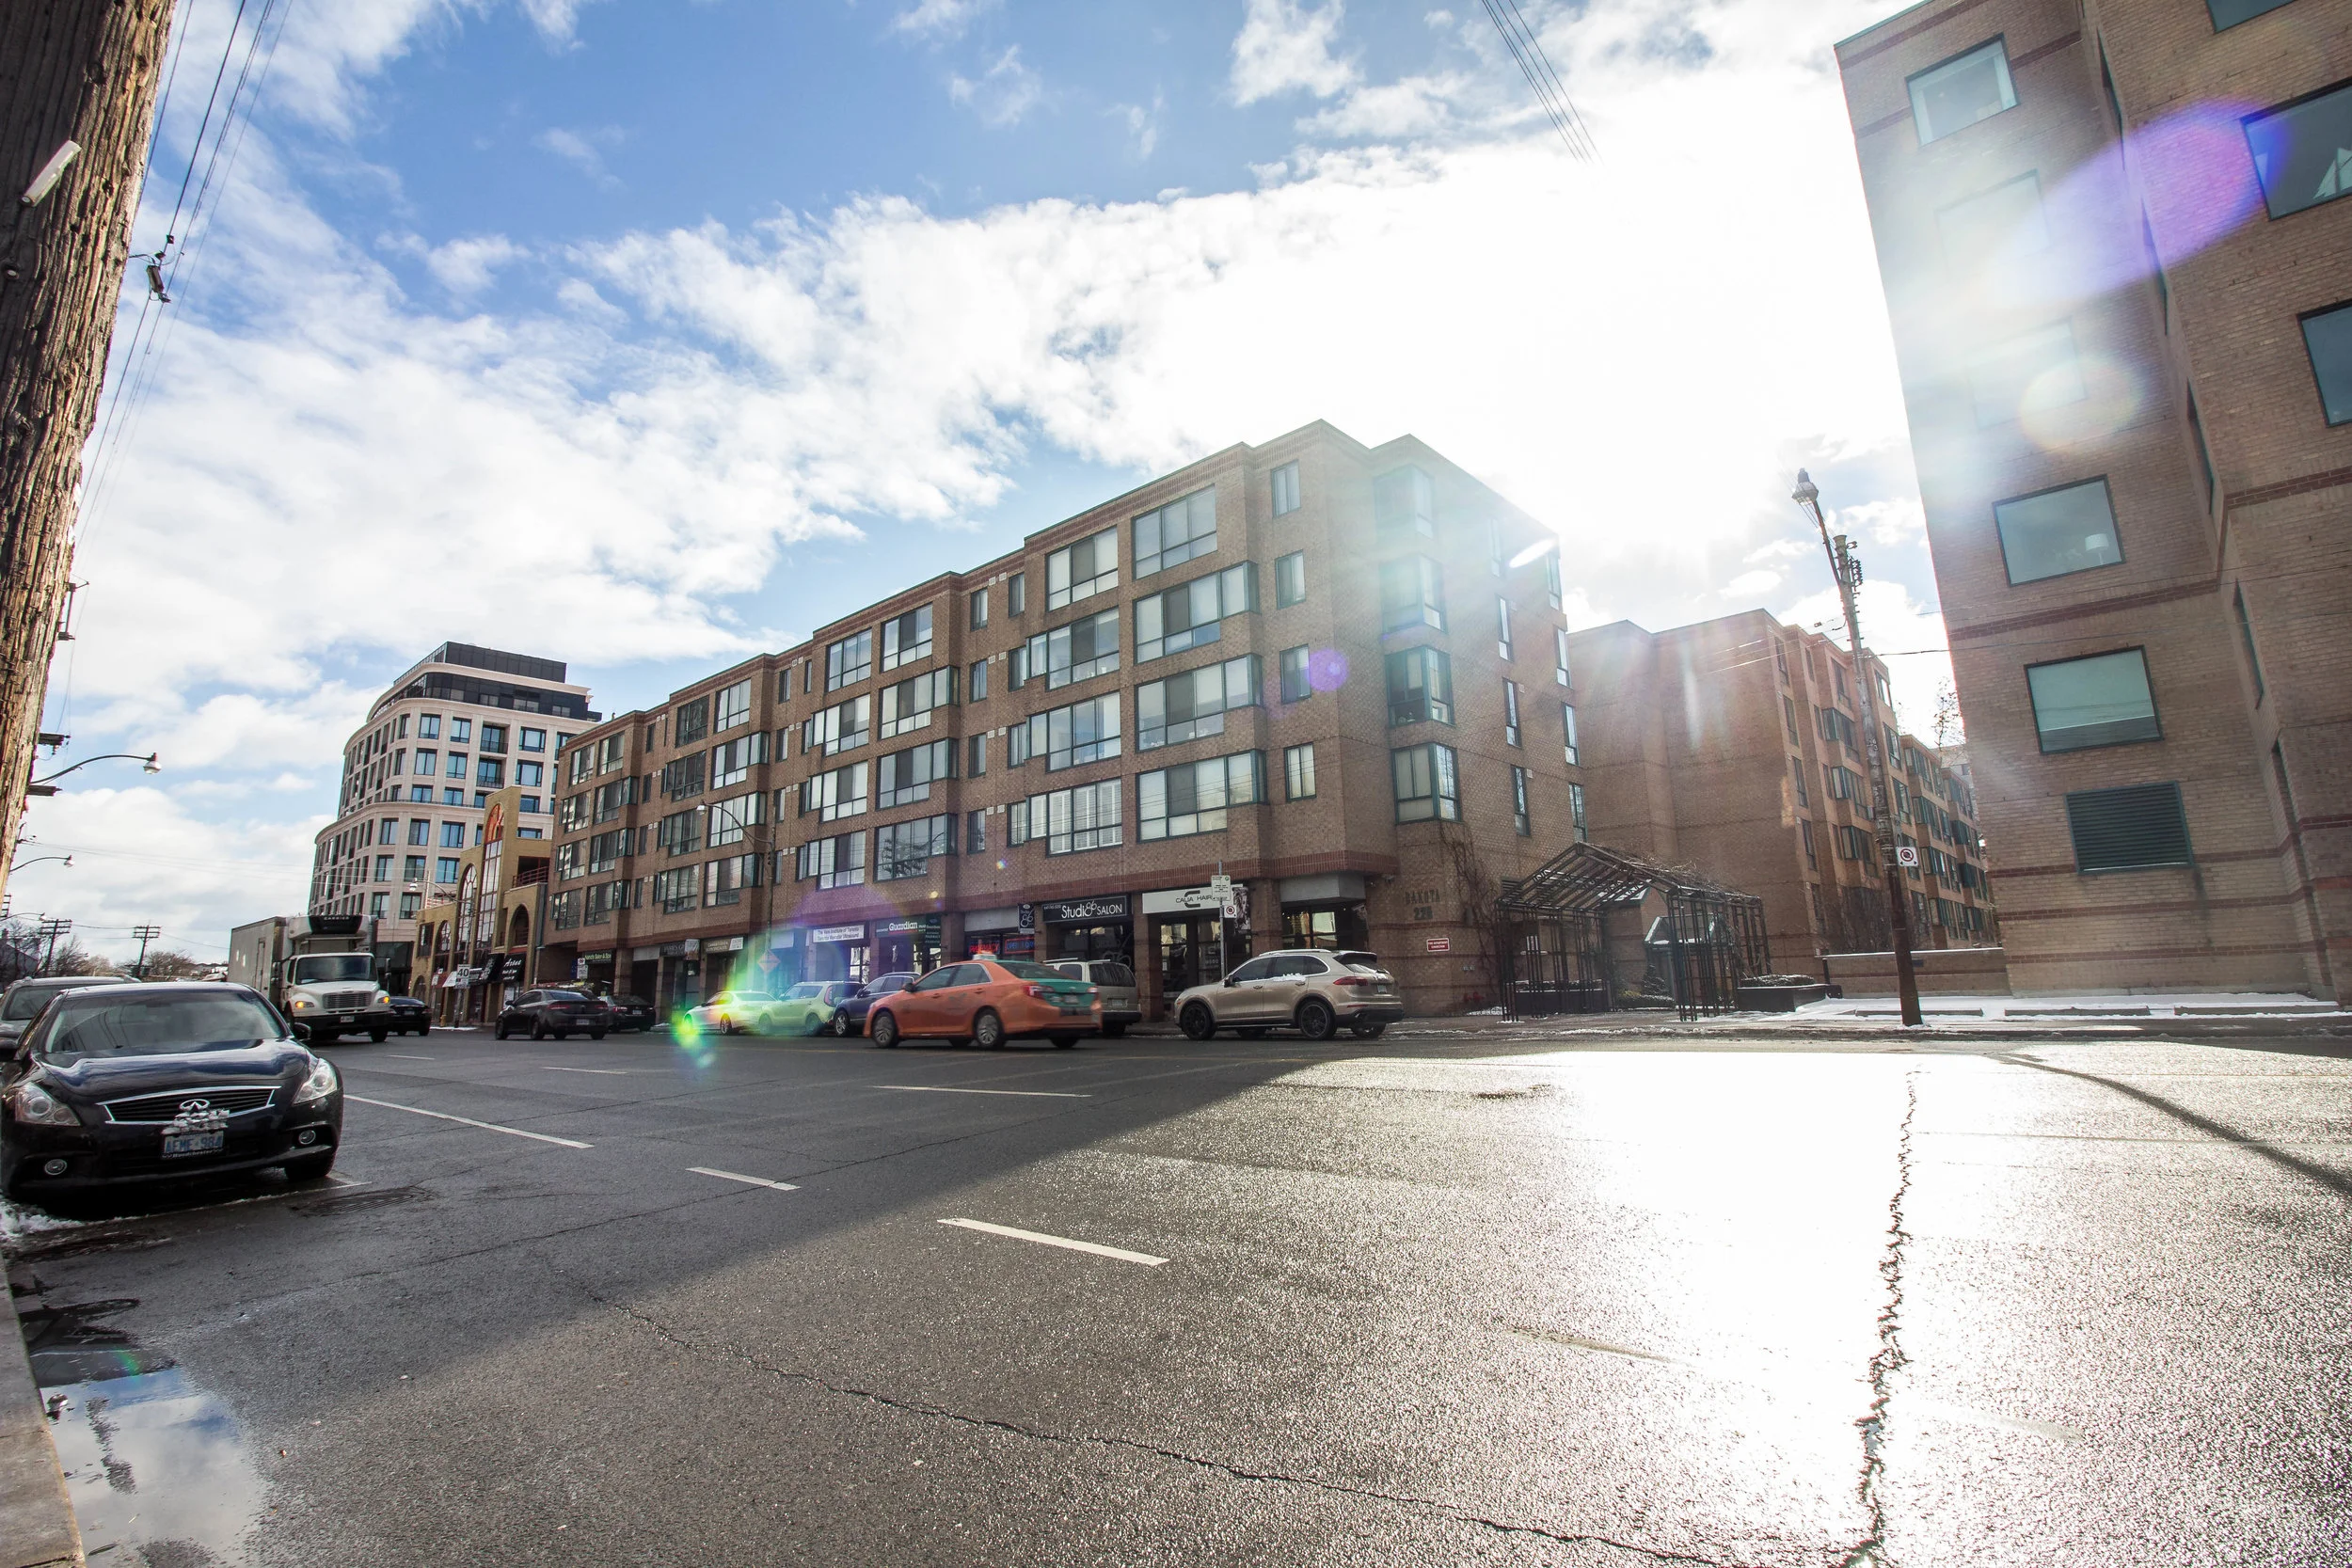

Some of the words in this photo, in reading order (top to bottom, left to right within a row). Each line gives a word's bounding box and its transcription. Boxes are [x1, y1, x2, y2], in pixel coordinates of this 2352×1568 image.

[1096, 903, 1122, 915] SALON
[888, 921, 918, 931] Guardian
[457, 968, 469, 977] 40
